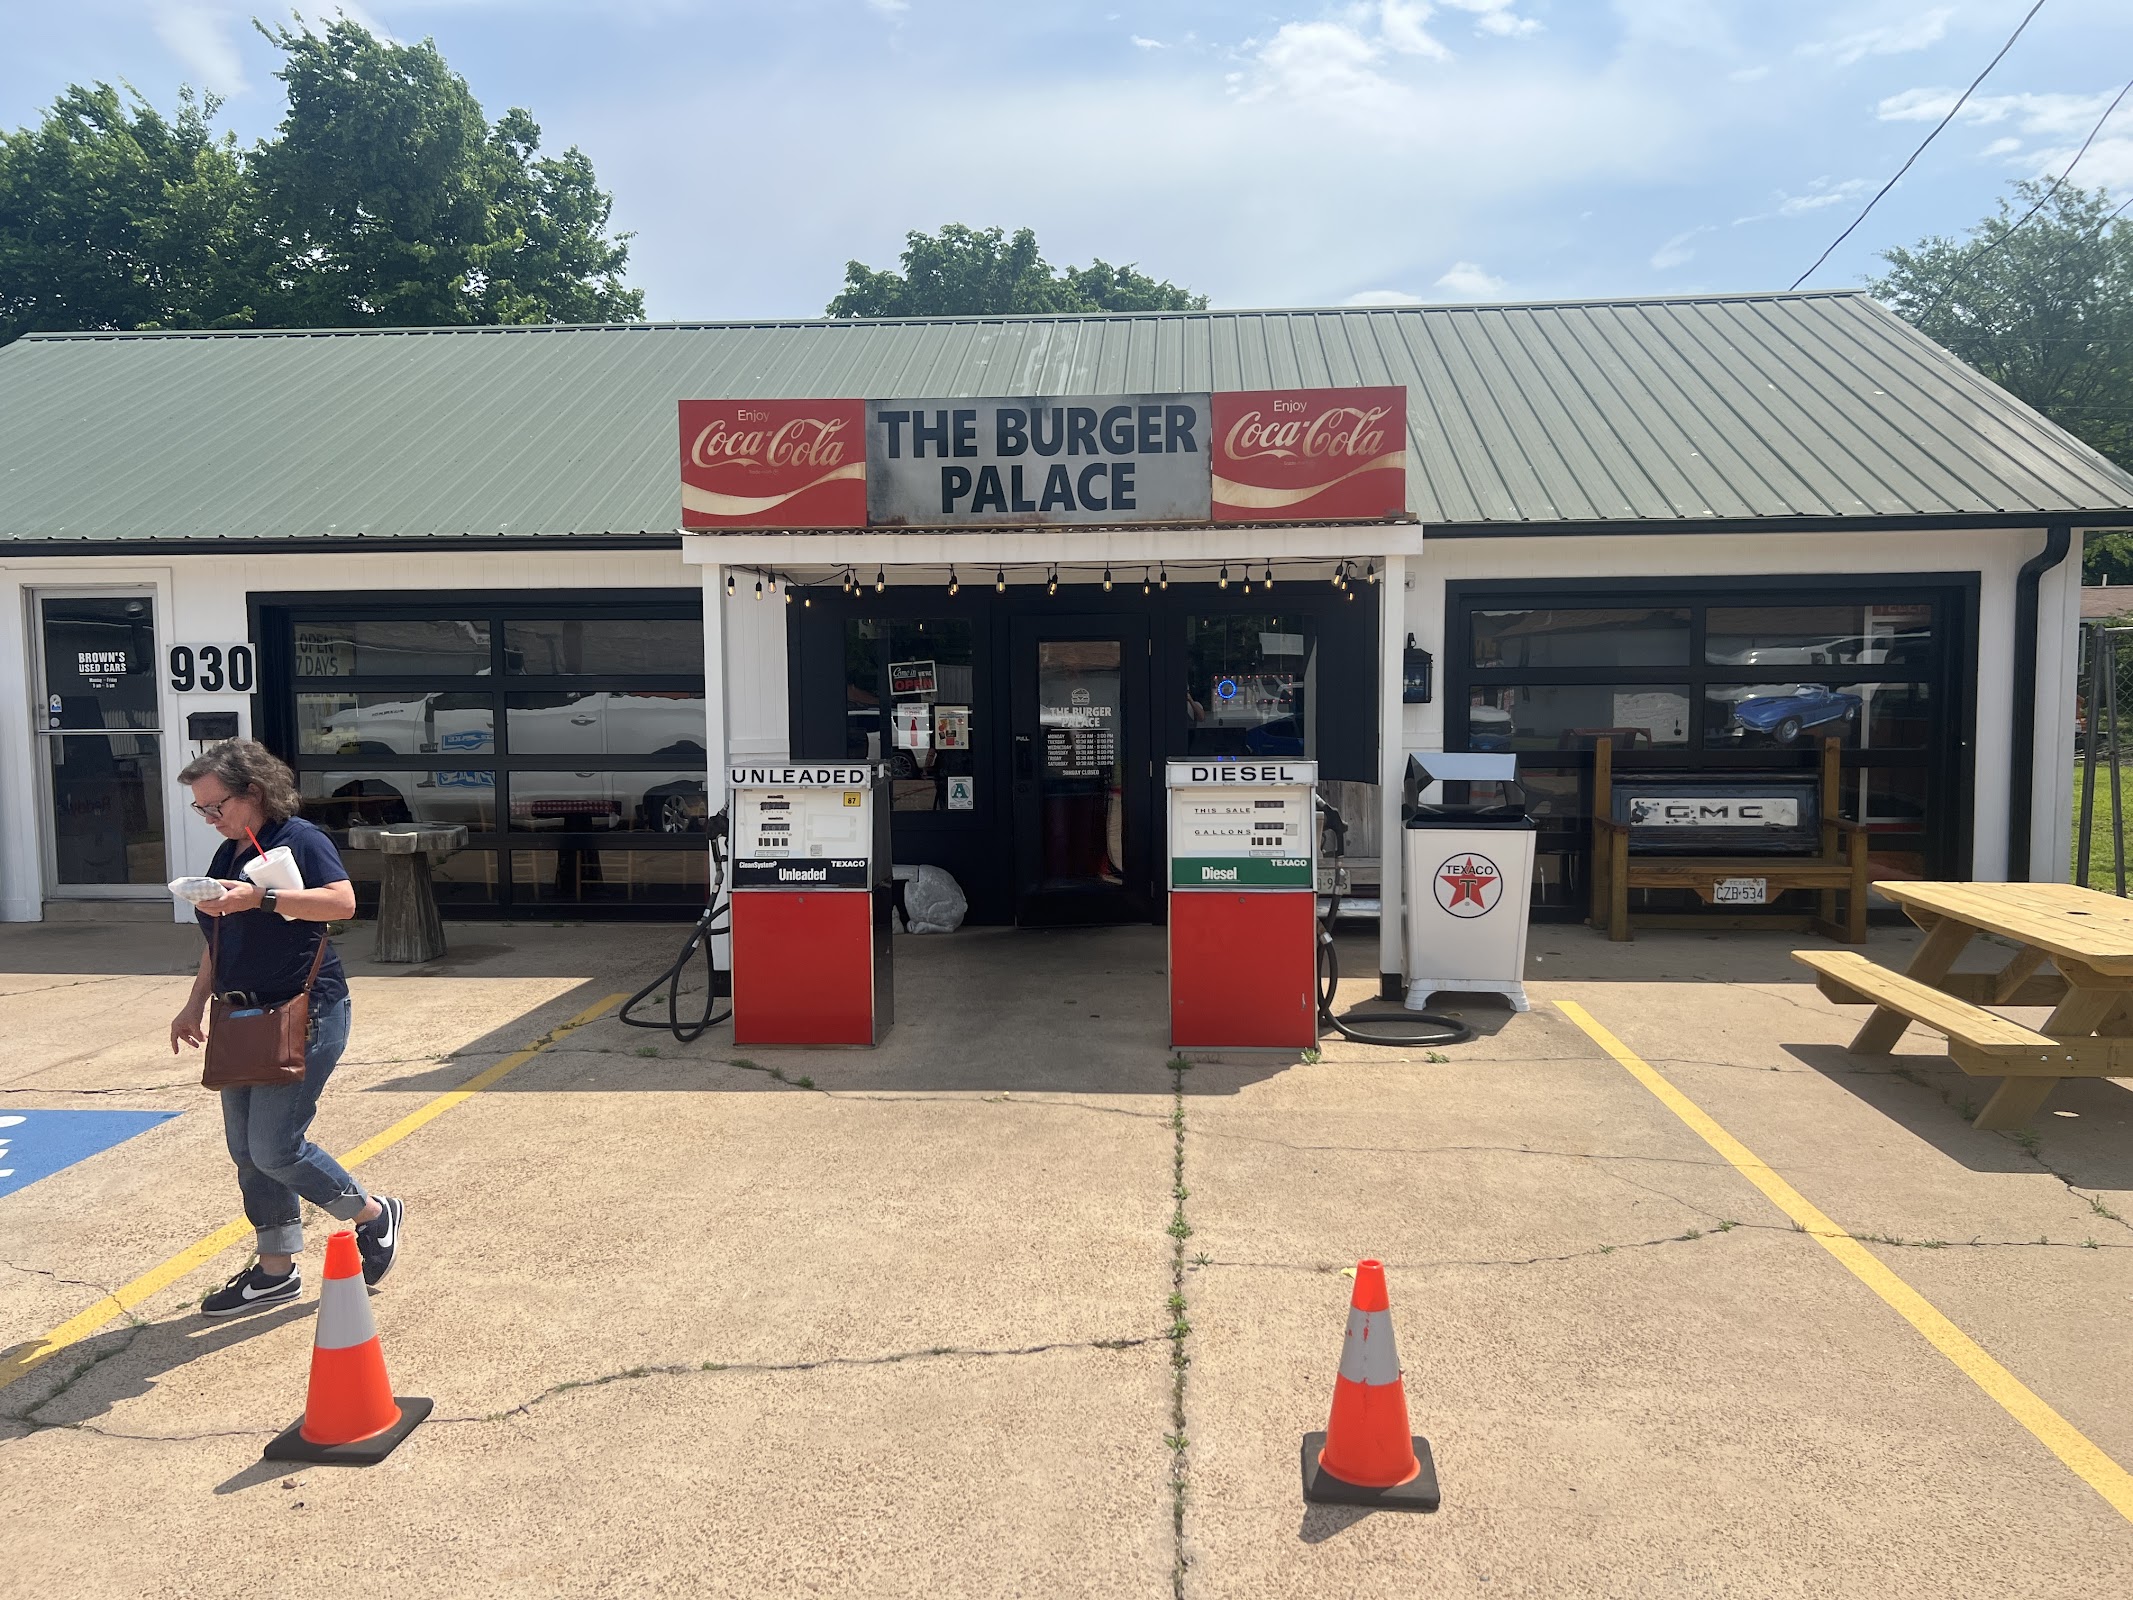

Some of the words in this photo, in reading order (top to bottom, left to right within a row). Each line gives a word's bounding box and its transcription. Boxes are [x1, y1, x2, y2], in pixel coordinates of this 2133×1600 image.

[1273, 400, 1307, 414] Enjoy
[737, 409, 770, 423] Enjoy
[877, 409, 978, 459] THE
[996, 404, 1198, 457] BURGER
[1224, 405, 1392, 460] Coca-Cola
[691, 417, 851, 468] Coca-Cola
[941, 462, 1136, 514] PALACE
[299, 633, 334, 654] OPEN
[78, 651, 126, 663] BROWN'S
[78, 663, 101, 672] USED
[103, 663, 127, 672] CARS
[169, 645, 253, 692] 930
[295, 655, 302, 674] 7
[305, 655, 338, 676] DAYS
[893, 666, 909, 677] Come
[910, 669, 917, 677] in
[894, 678, 934, 691] OPEN
[1050, 707, 1069, 717] THE
[1072, 706, 1112, 717] BURGER
[1061, 717, 1100, 727] PALACE
[731, 769, 865, 784] UNLEADED
[1192, 766, 1294, 782] DIESEL
[951, 783, 969, 798] A
[847, 797, 857, 805] 87
[1664, 804, 1764, 819] GMC
[830, 860, 865, 868] TEXACO
[1271, 859, 1307, 867] TEXACO
[1445, 865, 1494, 875] TEXACO
[778, 867, 827, 881] Unleaded
[1202, 866, 1238, 880] Diesel
[1459, 878, 1477, 899] T
